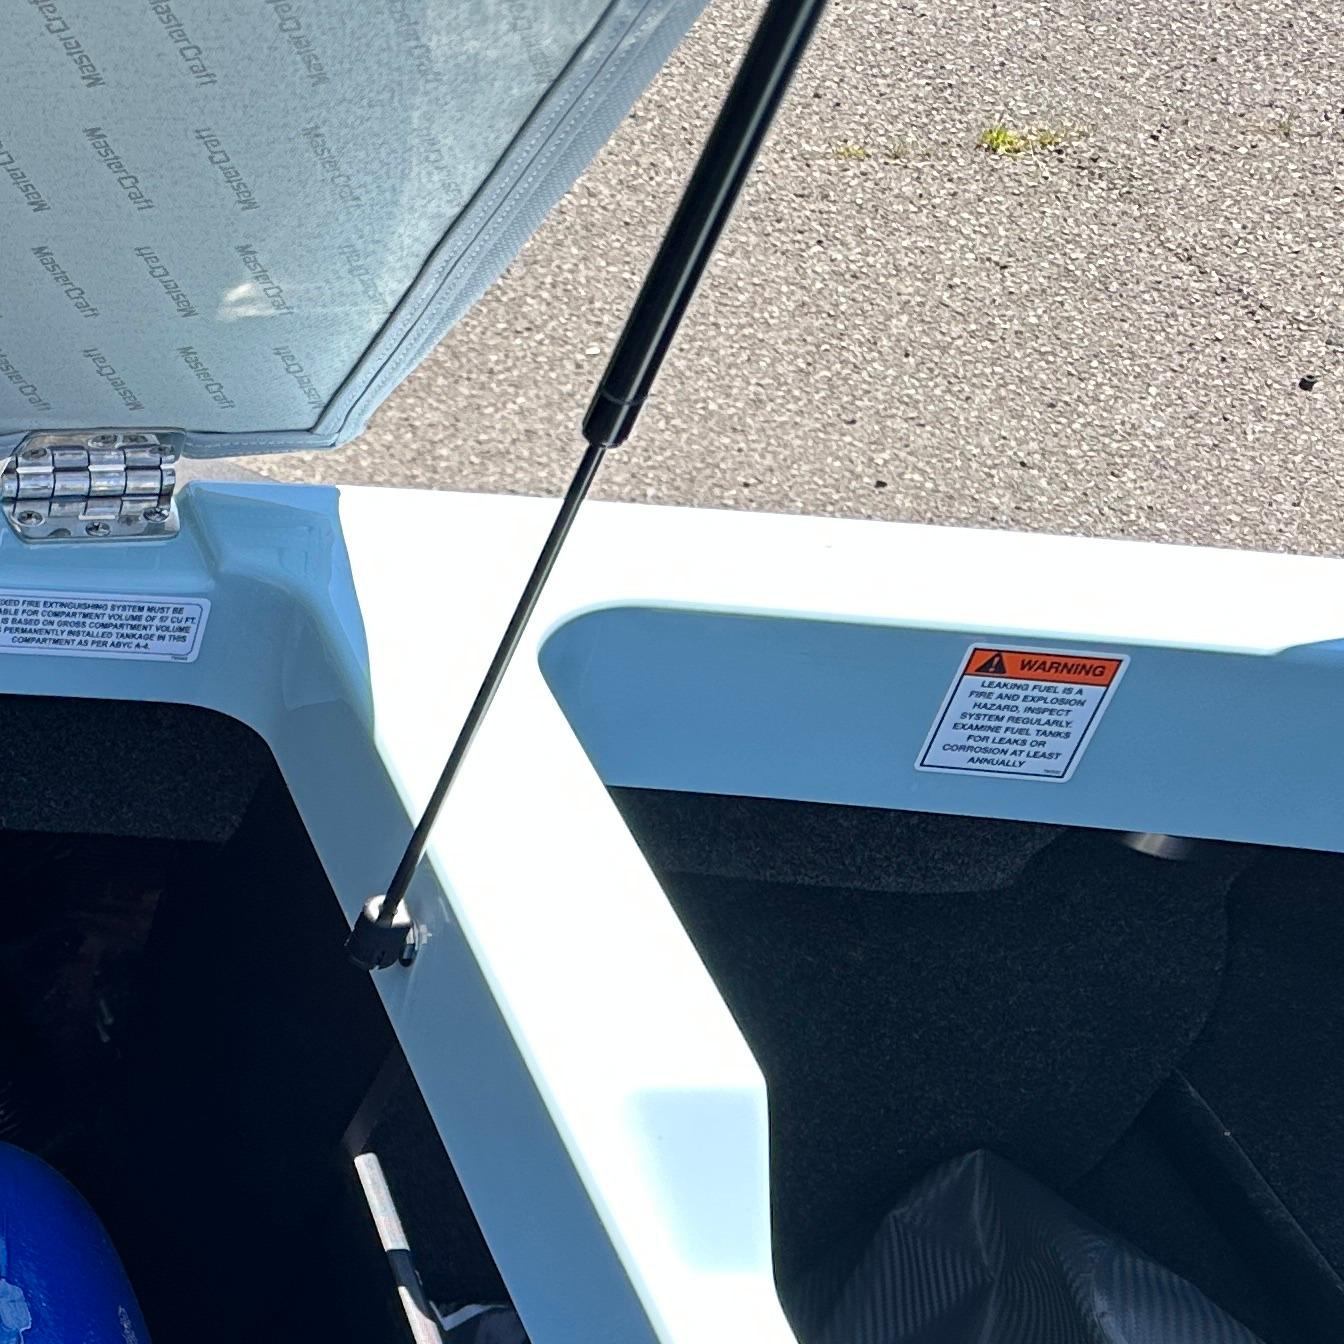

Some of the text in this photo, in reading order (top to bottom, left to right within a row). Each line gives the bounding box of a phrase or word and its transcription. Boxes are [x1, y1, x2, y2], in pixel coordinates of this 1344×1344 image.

[83, 126, 155, 211] MasterCraft
[194, 127, 260, 212] MasterCraft
[32, 245, 100, 319] MasterCraft
[135, 245, 199, 319] MasterCraft
[235, 243, 294, 316] MasterCraft
[21, 608, 39, 617] FOR
[41, 610, 106, 620] COMPARTMENT
[108, 613, 143, 621] VOLUME
[170, 616, 183, 624] CU
[42, 600, 108, 611] EXTINGUISHING
[110, 604, 145, 612] SYSTEM
[146, 605, 171, 614] MUST
[172, 607, 184, 615] BE
[11, 618, 40, 626] BASED
[42, 619, 55, 627] ON
[57, 620, 87, 629] GROSS
[88, 621, 153, 631] COMPARTMENT
[155, 625, 192, 633] VOLUME
[3, 627, 65, 637] PERMANENTLY
[67, 629, 113, 639] INSTALLED
[115, 632, 155, 641] TANKAGE
[157, 634, 166, 642] IN
[168, 635, 187, 643] THIS
[11, 635, 76, 646] COMPARTMENT
[77, 639, 89, 647] AS
[90, 640, 108, 648] PER
[109, 641, 133, 649] ABYC
[1019, 658, 1106, 677] WARNING
[980, 680, 1084, 696] LEAKING FUEL IS A
[968, 690, 1087, 707] FIRE AND EXPLOSION
[972, 701, 1073, 717] HAZARD, INSPECT
[960, 712, 1073, 729] SYSTEM REGULARLY.
[952, 722, 1072, 740] EXAMINE FUEL TANKS
[966, 735, 1047, 748] FOR LEAKS OR
[941, 743, 1062, 761] CORROSION AT LEAST
[967, 757, 1025, 769] ANNUALLY
